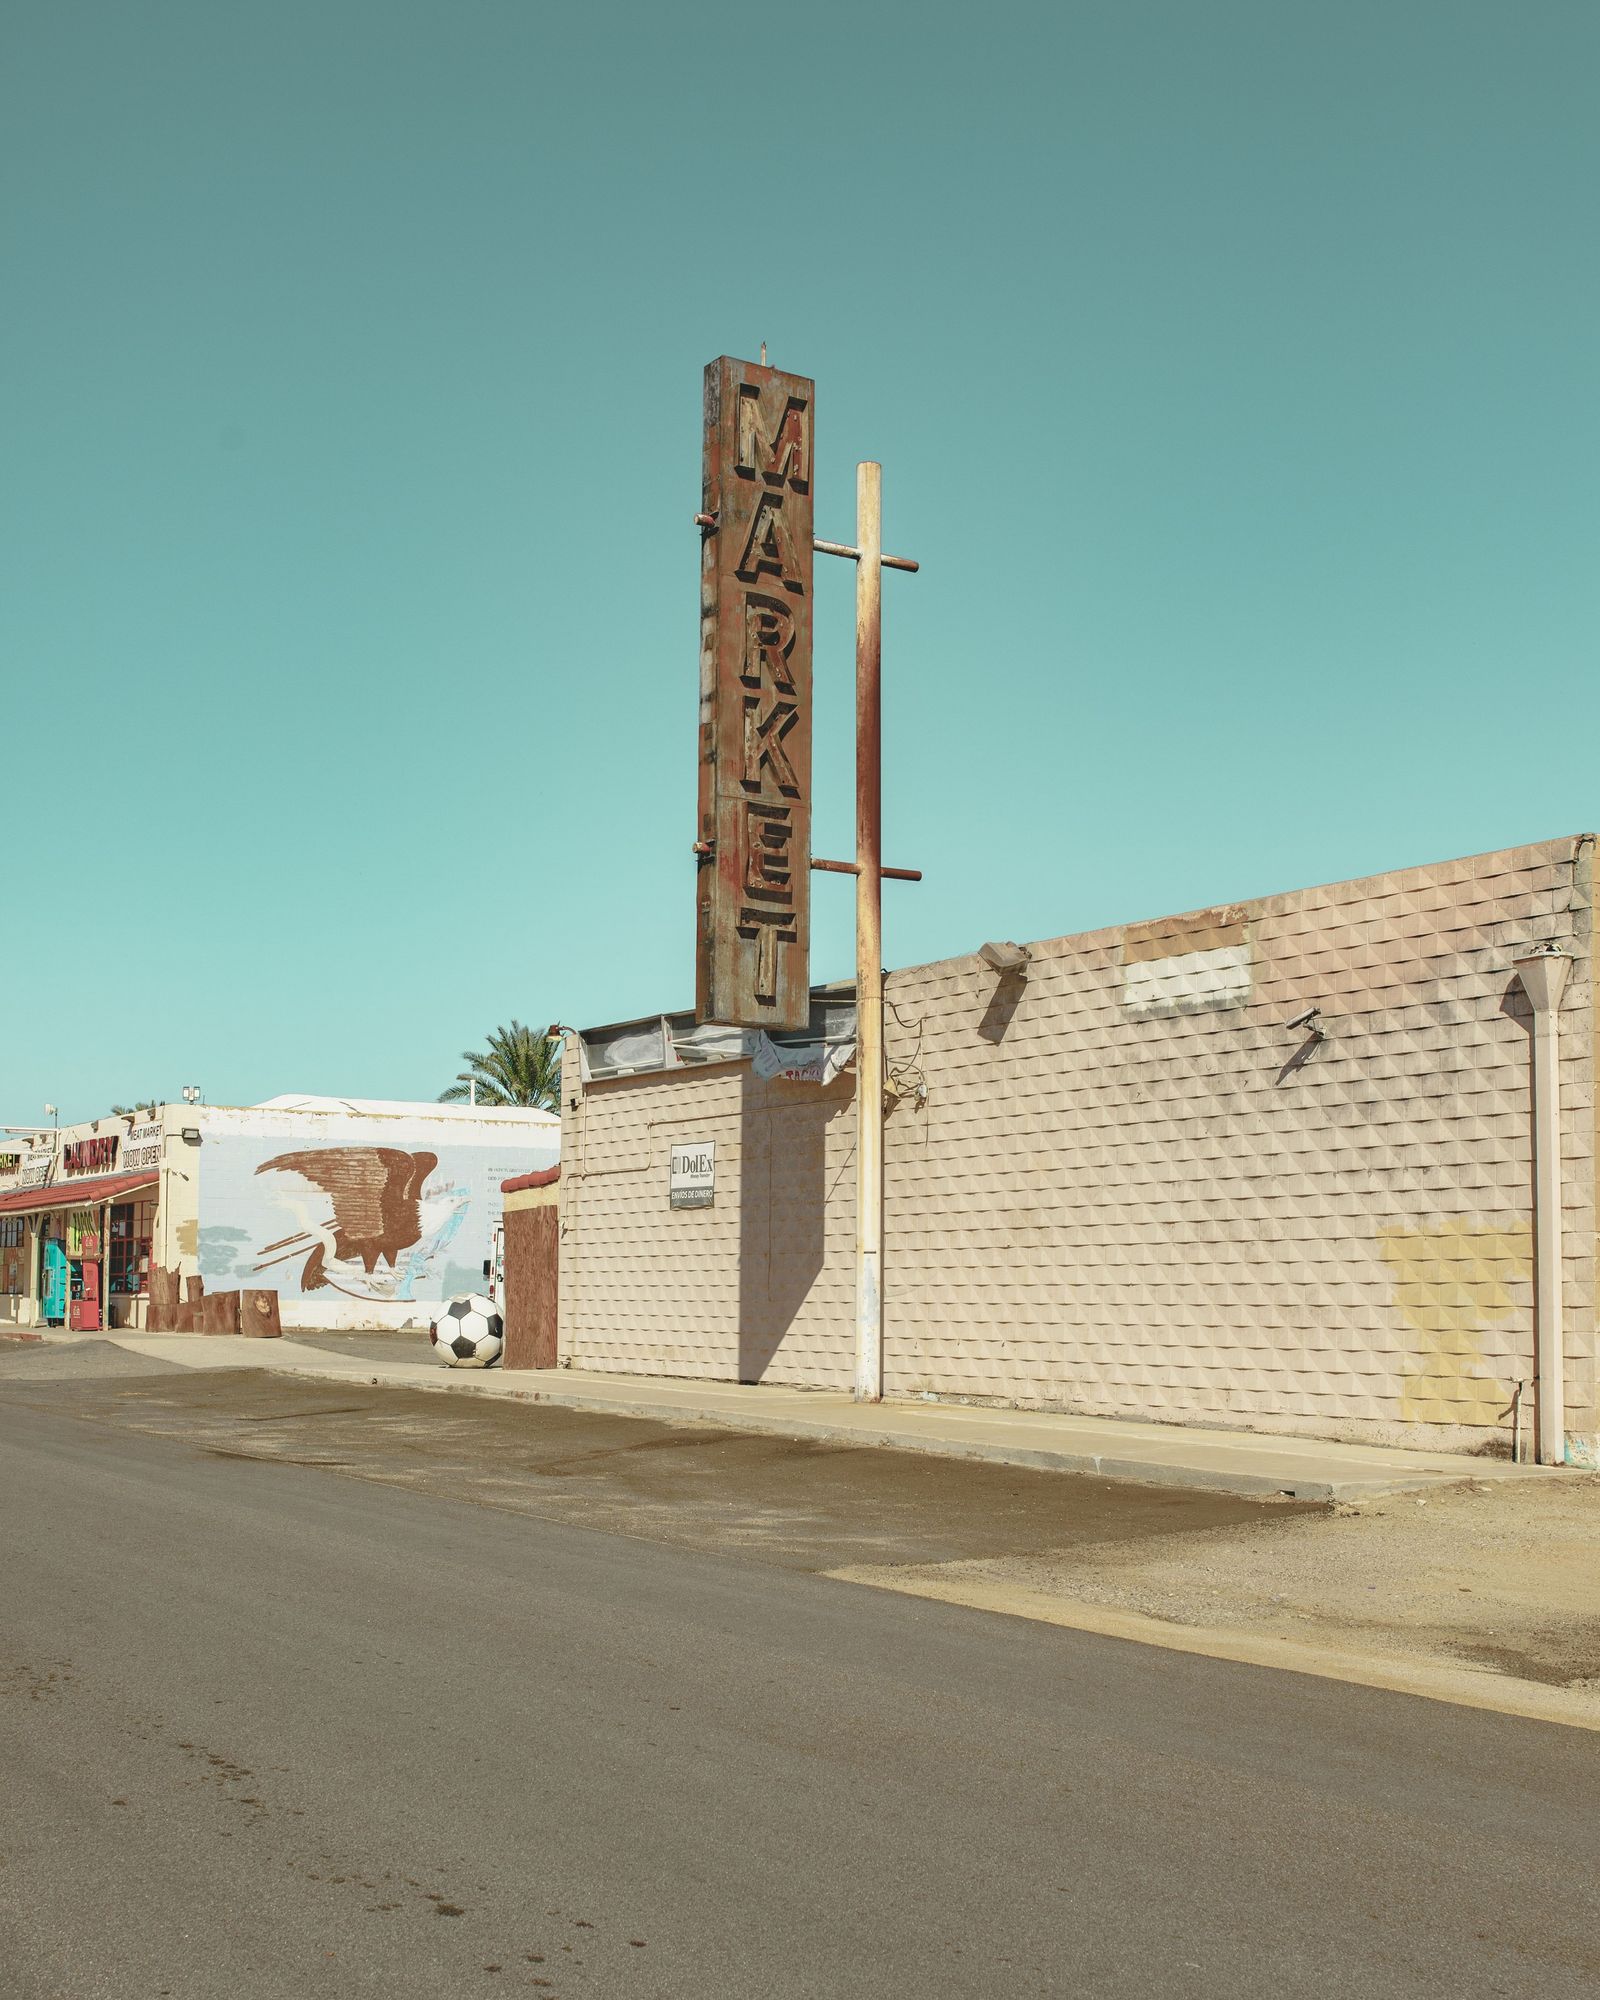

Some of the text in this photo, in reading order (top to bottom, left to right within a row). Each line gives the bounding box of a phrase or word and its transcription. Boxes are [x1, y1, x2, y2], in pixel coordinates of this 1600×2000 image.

[735, 383, 809, 1006] MARKET
[143, 1125, 162, 1138] MARKET
[122, 1145, 161, 1168] NOW OPEN
[682, 1154, 713, 1174] DolEx
[688, 1190, 695, 1198] DE
[695, 1189, 713, 1198] DINERO
